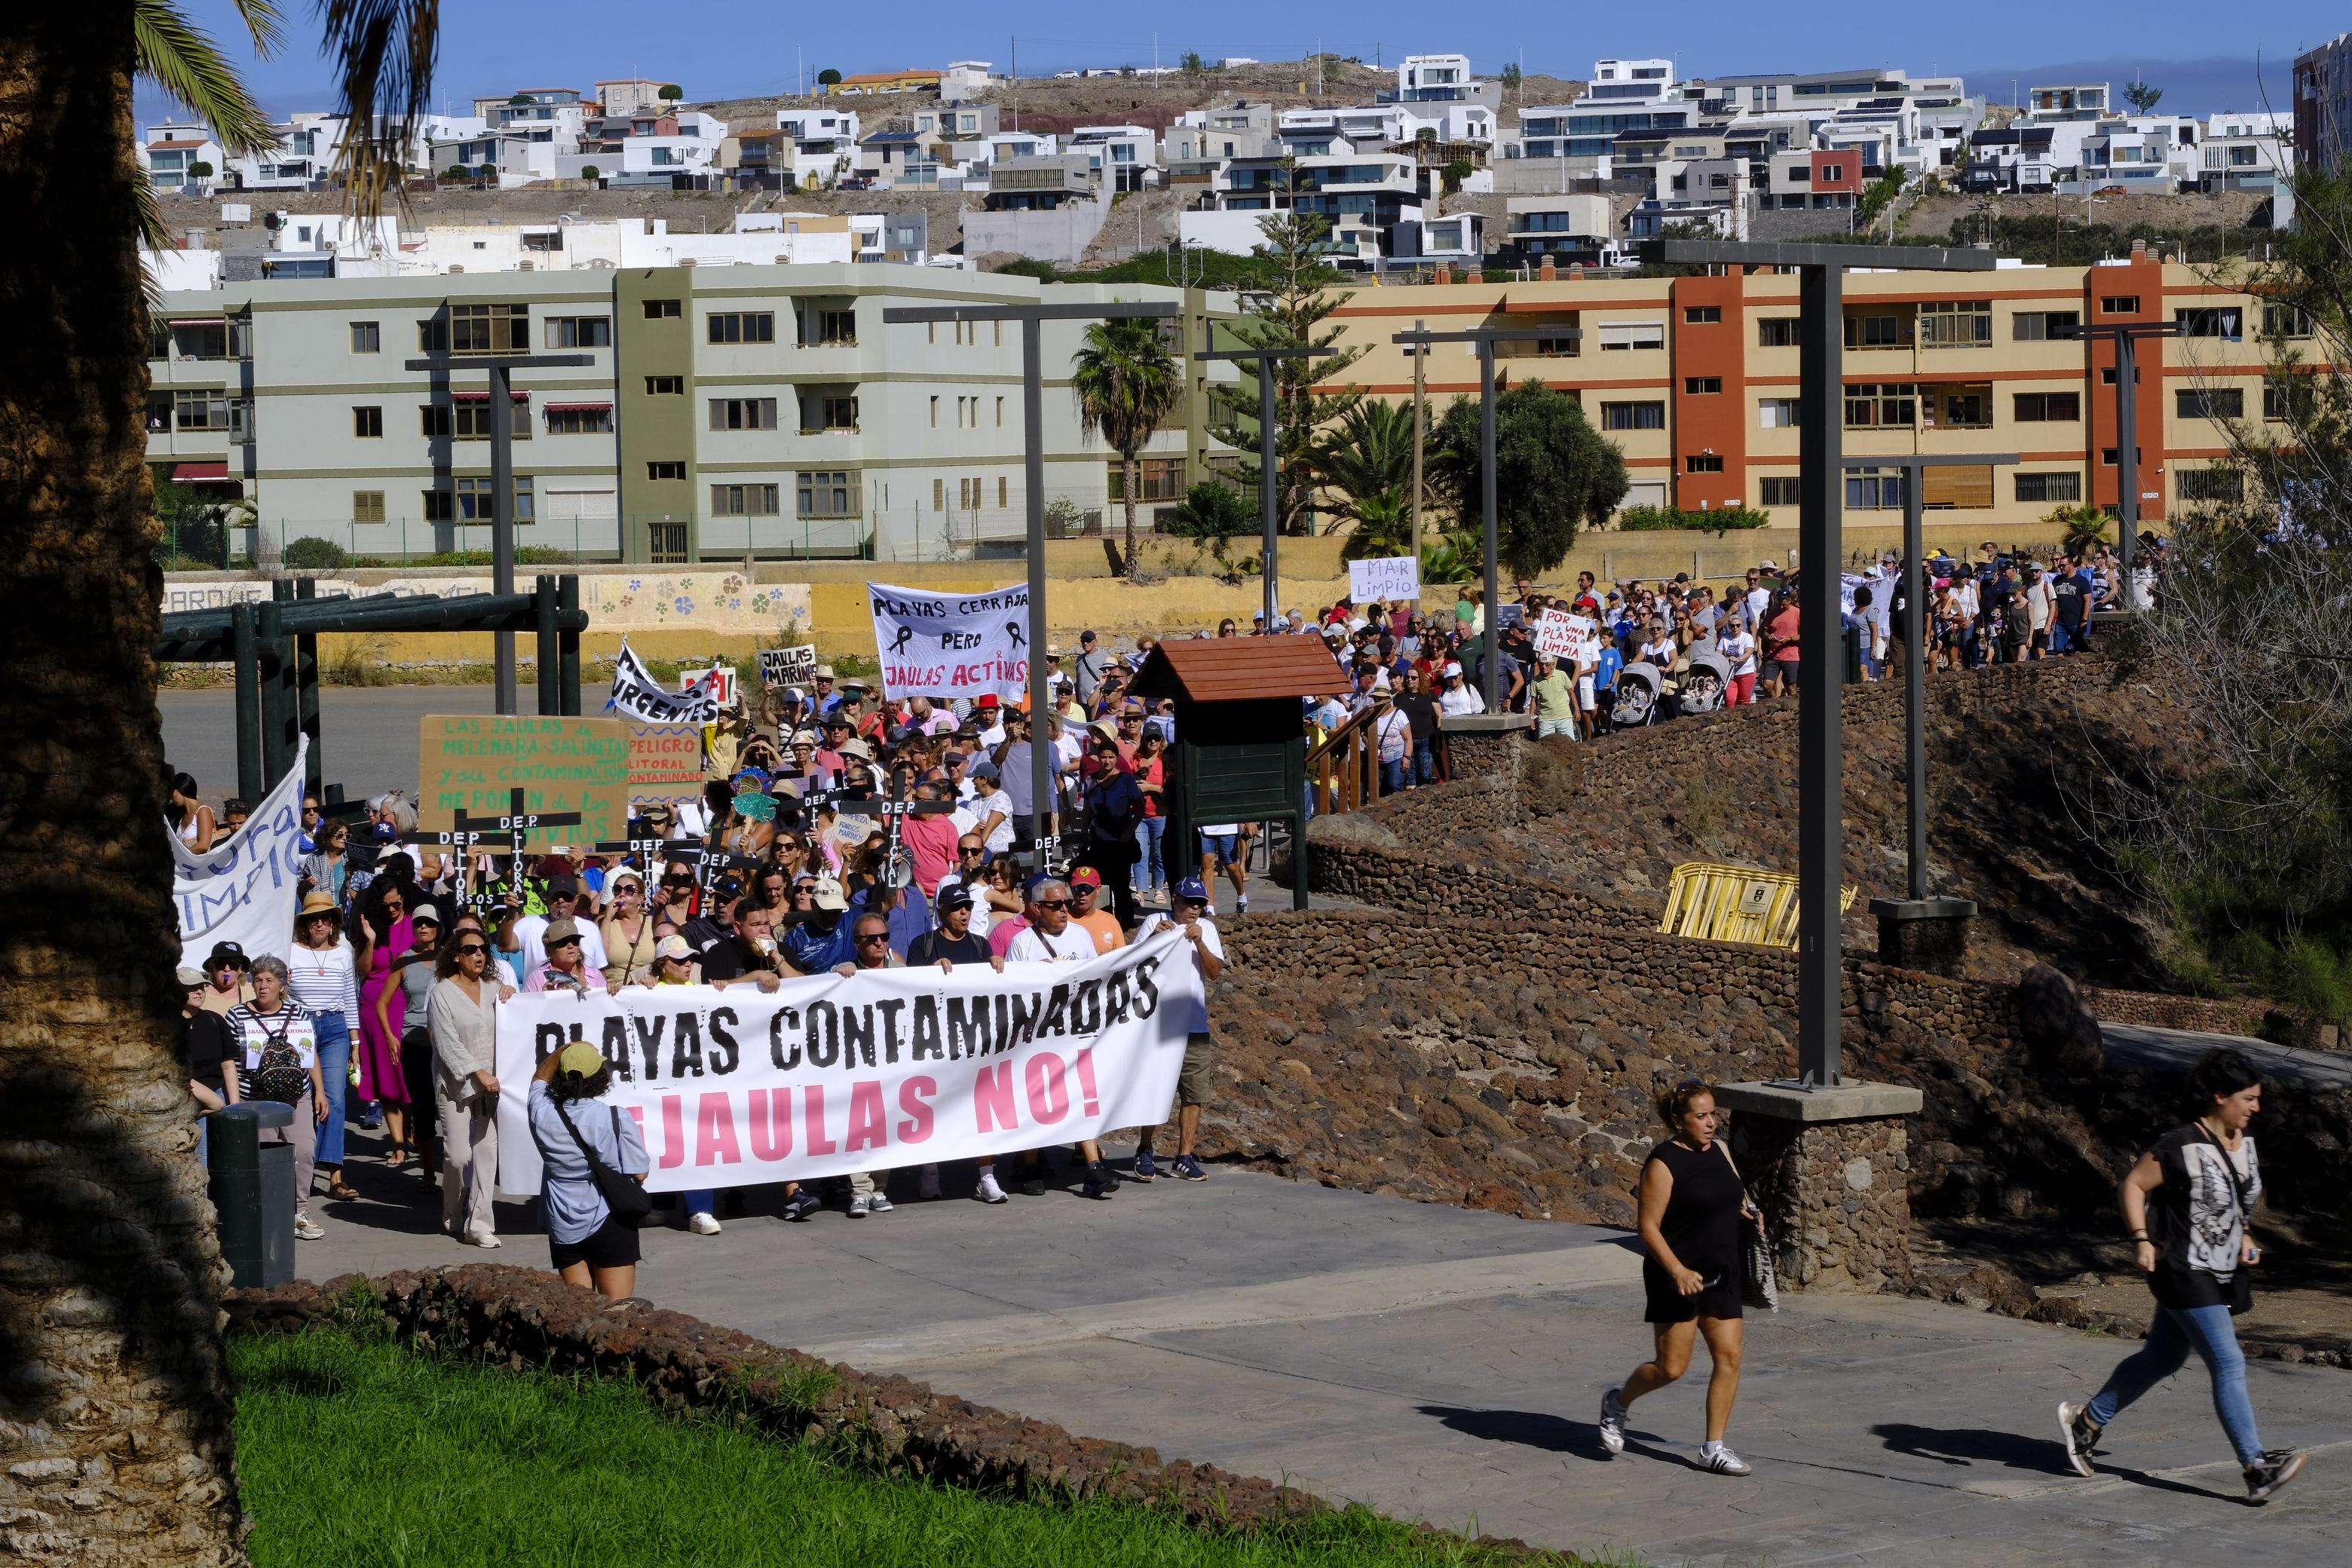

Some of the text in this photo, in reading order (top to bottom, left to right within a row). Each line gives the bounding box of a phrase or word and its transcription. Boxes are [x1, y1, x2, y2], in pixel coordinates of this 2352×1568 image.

[1367, 560, 1409, 577] MAR
[873, 594, 1029, 617] PLAYAS CERRADA
[1546, 611, 1570, 624] POR
[1542, 626, 1578, 644] PLAYA
[1565, 625, 1585, 636] UNA
[942, 632, 982, 650] PERO
[762, 649, 813, 667] JAULAS
[884, 664, 945, 687] JAULAS
[611, 674, 717, 722] URGENTES
[445, 718, 481, 734] LAS
[492, 718, 563, 734] JAULAS
[629, 739, 695, 754] PELIGRO
[629, 758, 685, 769] LITORAL
[629, 773, 703, 782] ONTAMINADO
[439, 792, 464, 810] ME
[472, 790, 543, 810] PONN
[881, 801, 915, 814] D.E.P.
[500, 815, 537, 828] D.E.P.
[839, 821, 859, 832] FONDOS
[439, 831, 479, 845] D.E.P.
[630, 840, 663, 851] D.E.P.
[700, 852, 730, 867] D.E.P.
[770, 957, 1160, 1071] CONTAMINADAS
[535, 1006, 740, 1083] PAYAS
[973, 1048, 1100, 1134] NO!
